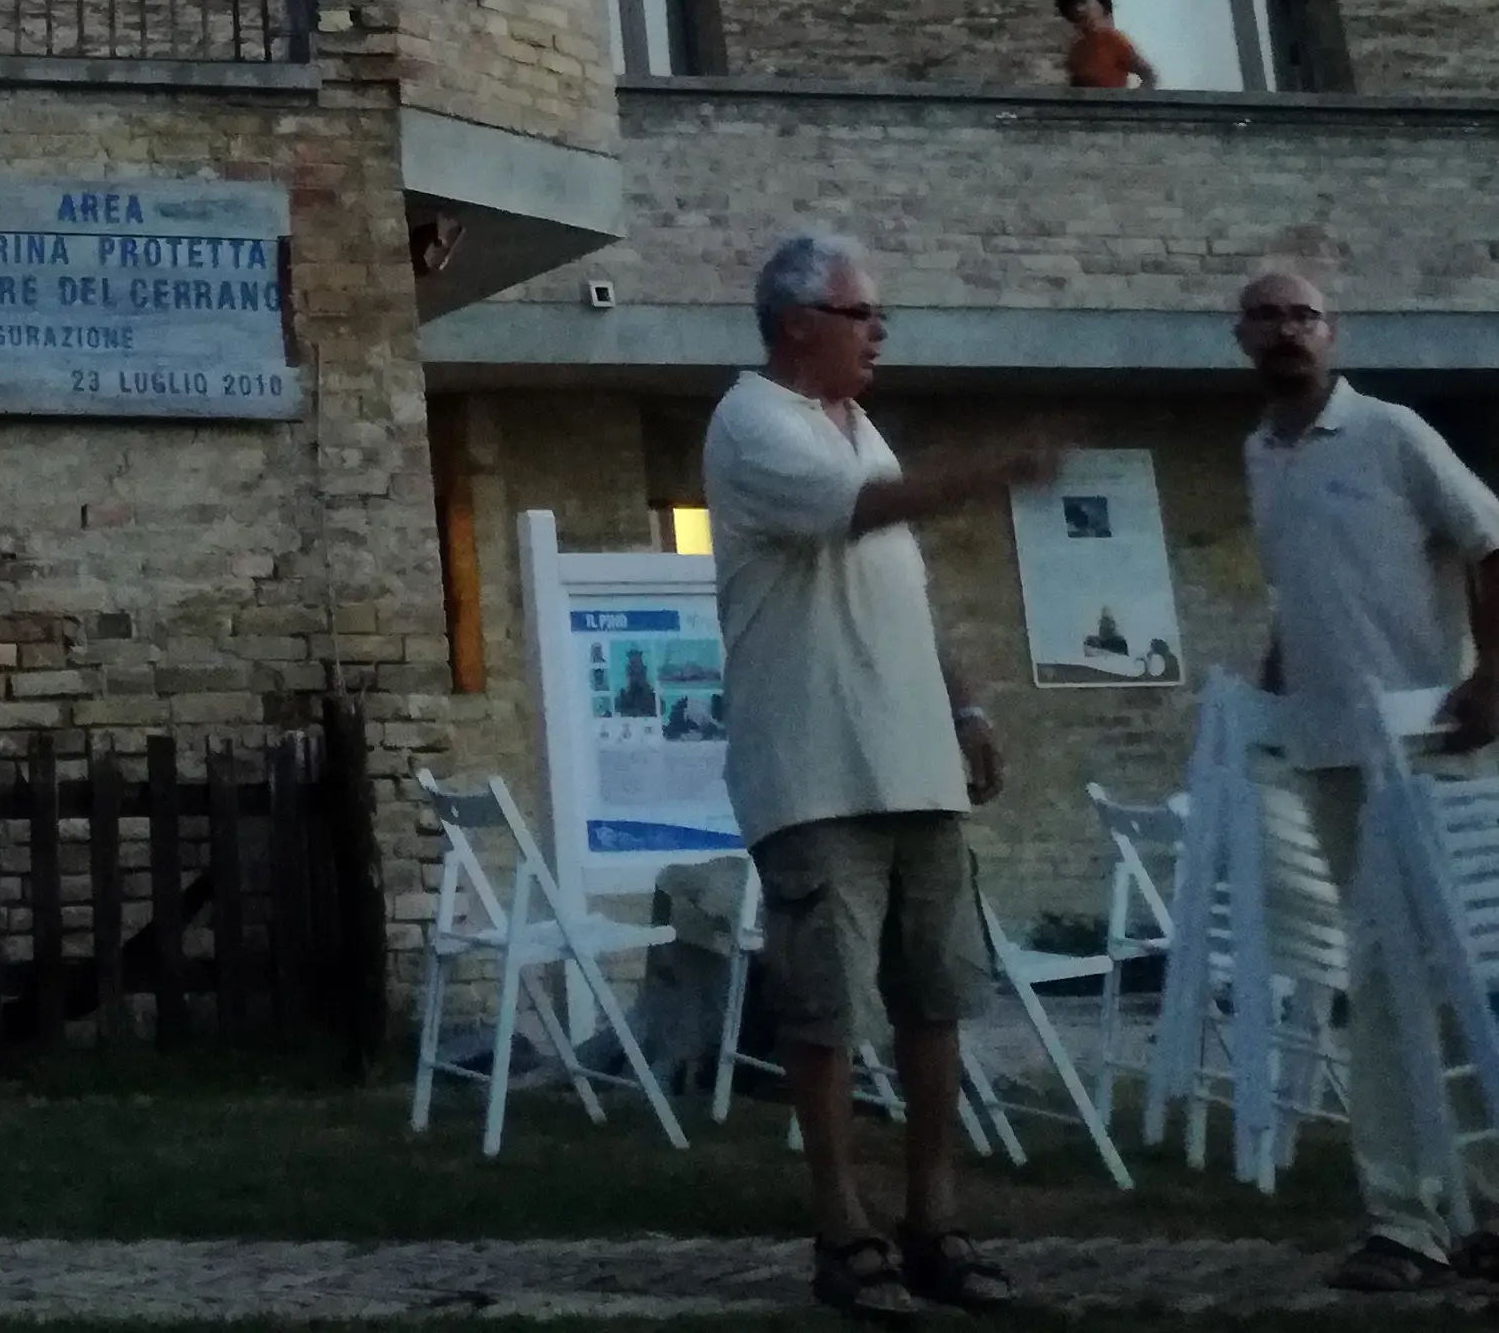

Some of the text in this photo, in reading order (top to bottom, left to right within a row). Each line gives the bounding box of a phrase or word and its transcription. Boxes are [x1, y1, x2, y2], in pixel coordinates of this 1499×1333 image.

[57, 194, 143, 224] AREA
[101, 238, 267, 269] PROTETTA
[58, 276, 113, 309] DEL
[130, 279, 282, 312] CERRANO
[72, 369, 283, 397] 23 LUGLIO 2010
